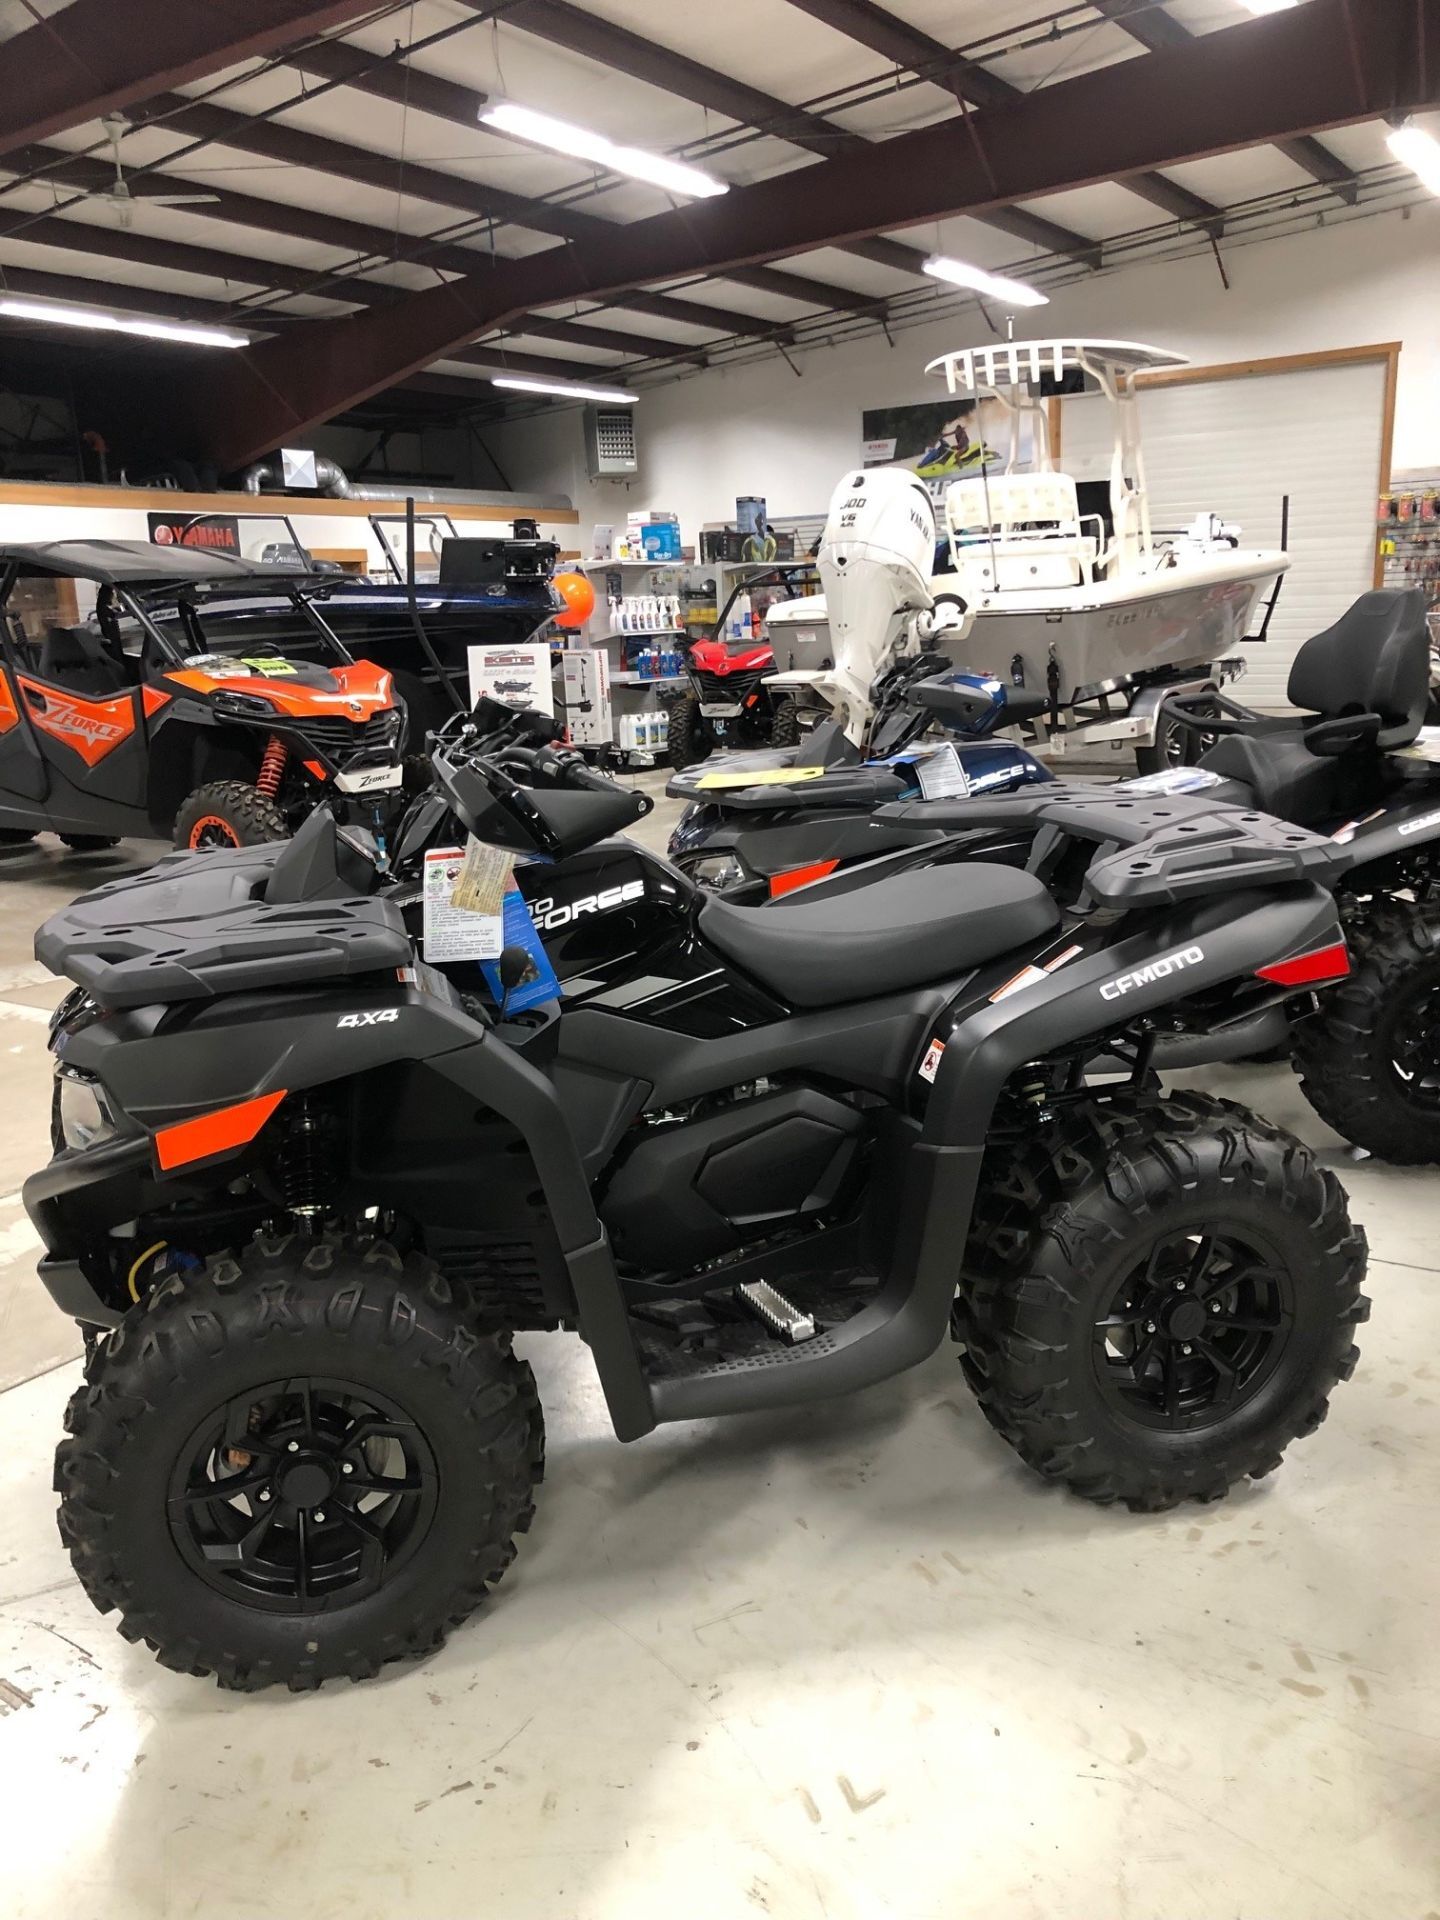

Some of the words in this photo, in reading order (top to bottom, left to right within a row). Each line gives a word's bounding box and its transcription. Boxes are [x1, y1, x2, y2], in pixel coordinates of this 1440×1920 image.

[839, 498, 867, 510] 00
[172, 525, 235, 547] YAMAHA
[1099, 946, 1205, 1001] CFMOTO
